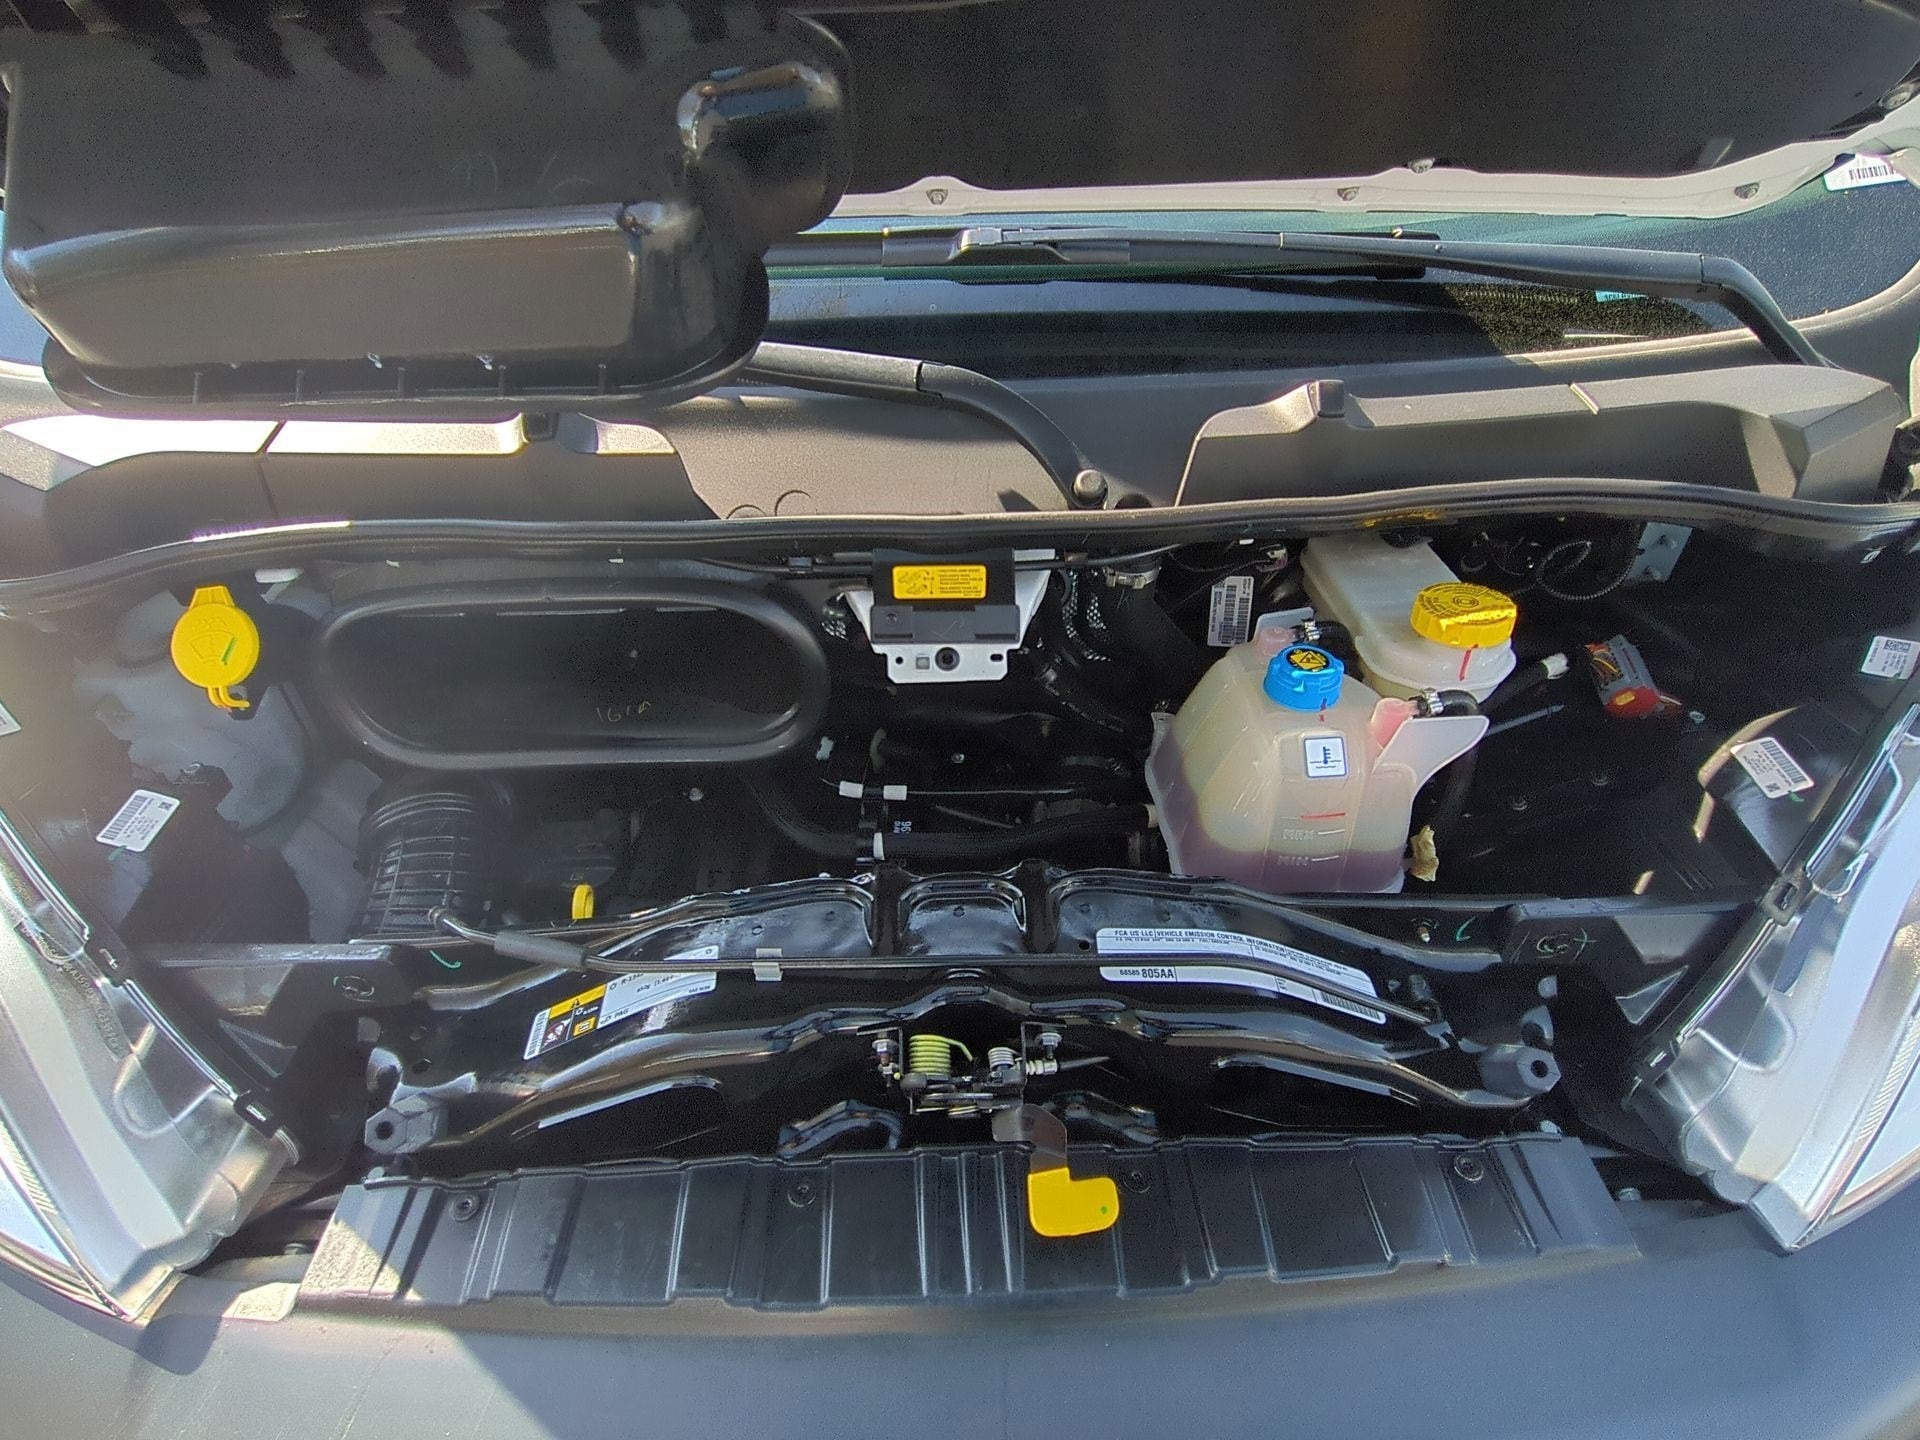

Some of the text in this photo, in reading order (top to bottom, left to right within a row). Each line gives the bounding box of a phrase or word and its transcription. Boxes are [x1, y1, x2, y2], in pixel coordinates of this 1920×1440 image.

[1156, 930, 1183, 938] VEHICLE
[1184, 931, 1215, 939] EMISSION
[1216, 932, 1245, 943] CONTROL
[1245, 935, 1285, 953] INFORMATION
[1142, 968, 1174, 979] 805AA
